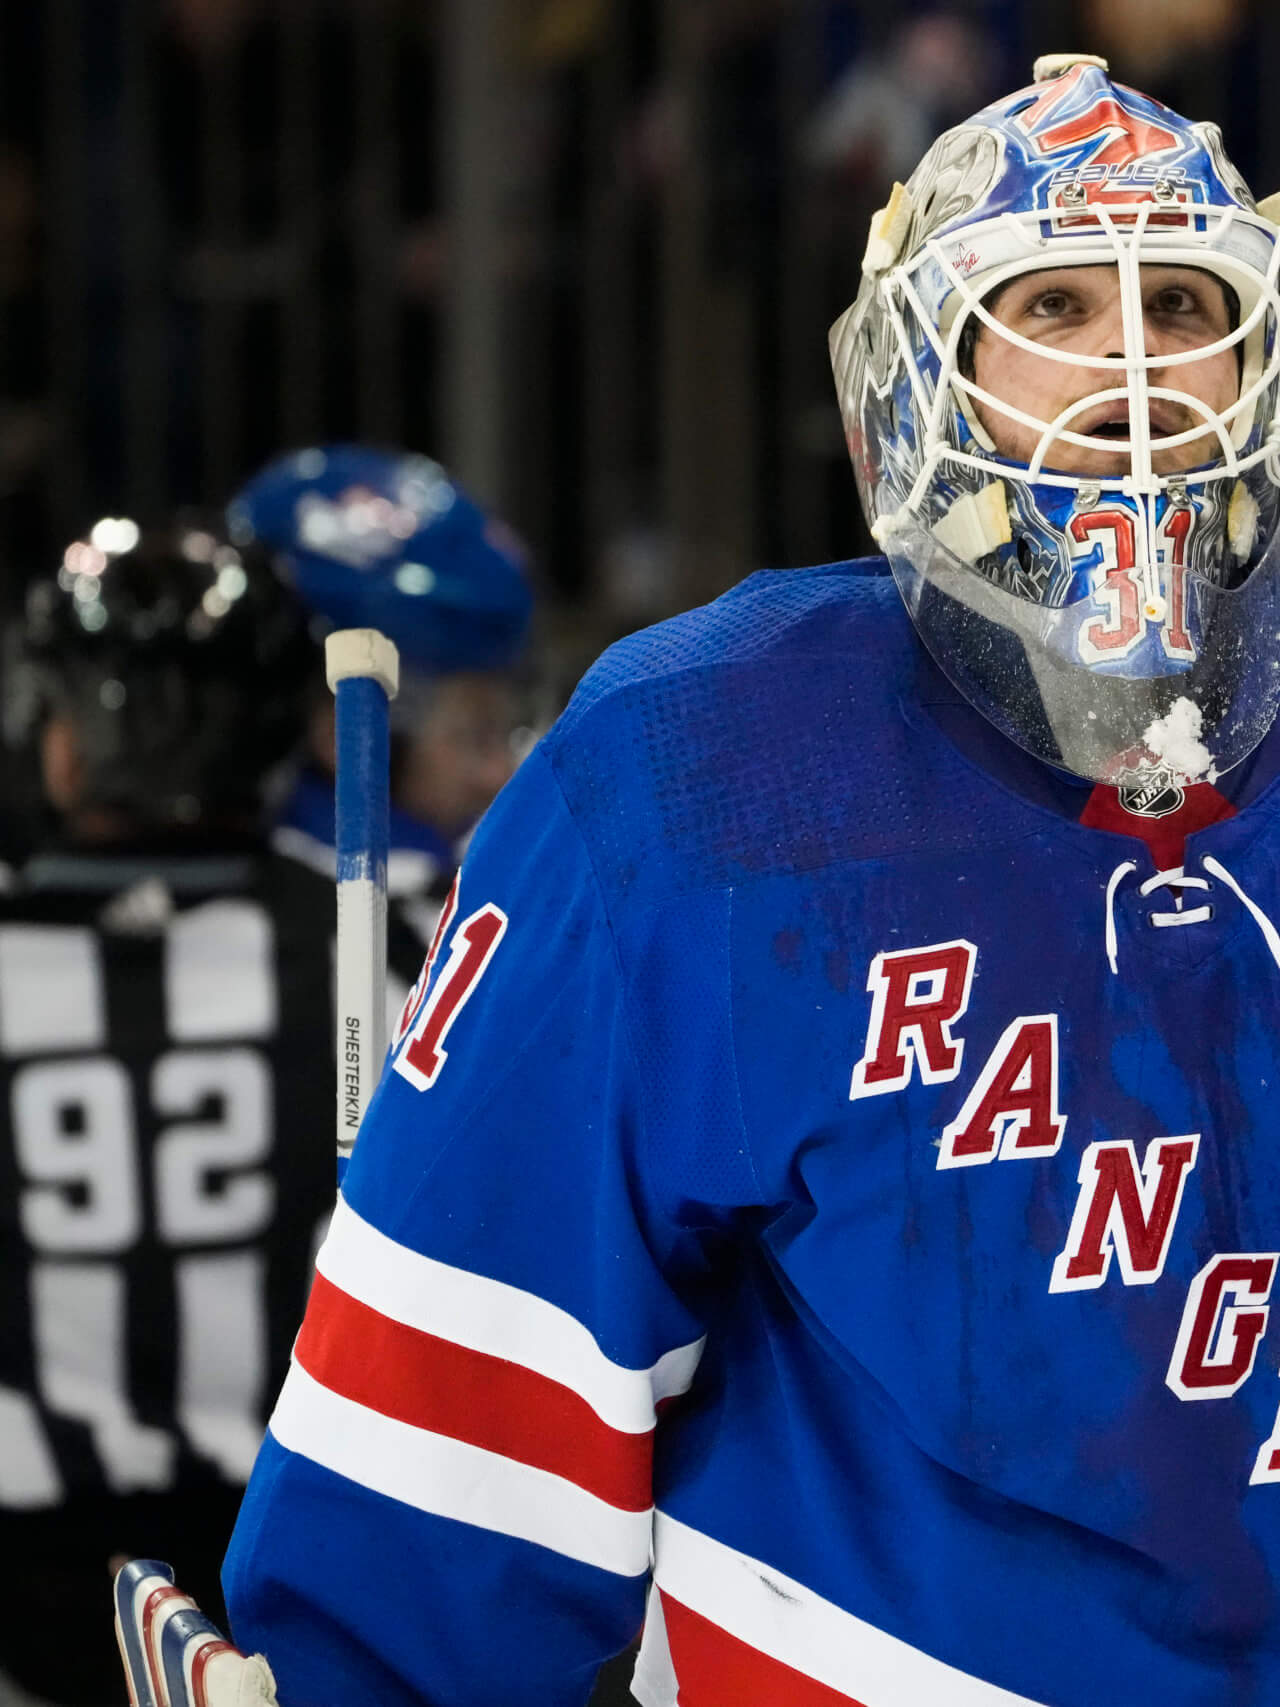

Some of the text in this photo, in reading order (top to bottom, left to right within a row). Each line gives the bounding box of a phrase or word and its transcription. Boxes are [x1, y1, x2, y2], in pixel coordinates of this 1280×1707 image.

[1049, 163, 1187, 188] BAUER
[1065, 502, 1197, 665] 31
[345, 1016, 361, 1129] SHESTERKIN
[11, 1047, 275, 1253] 92
